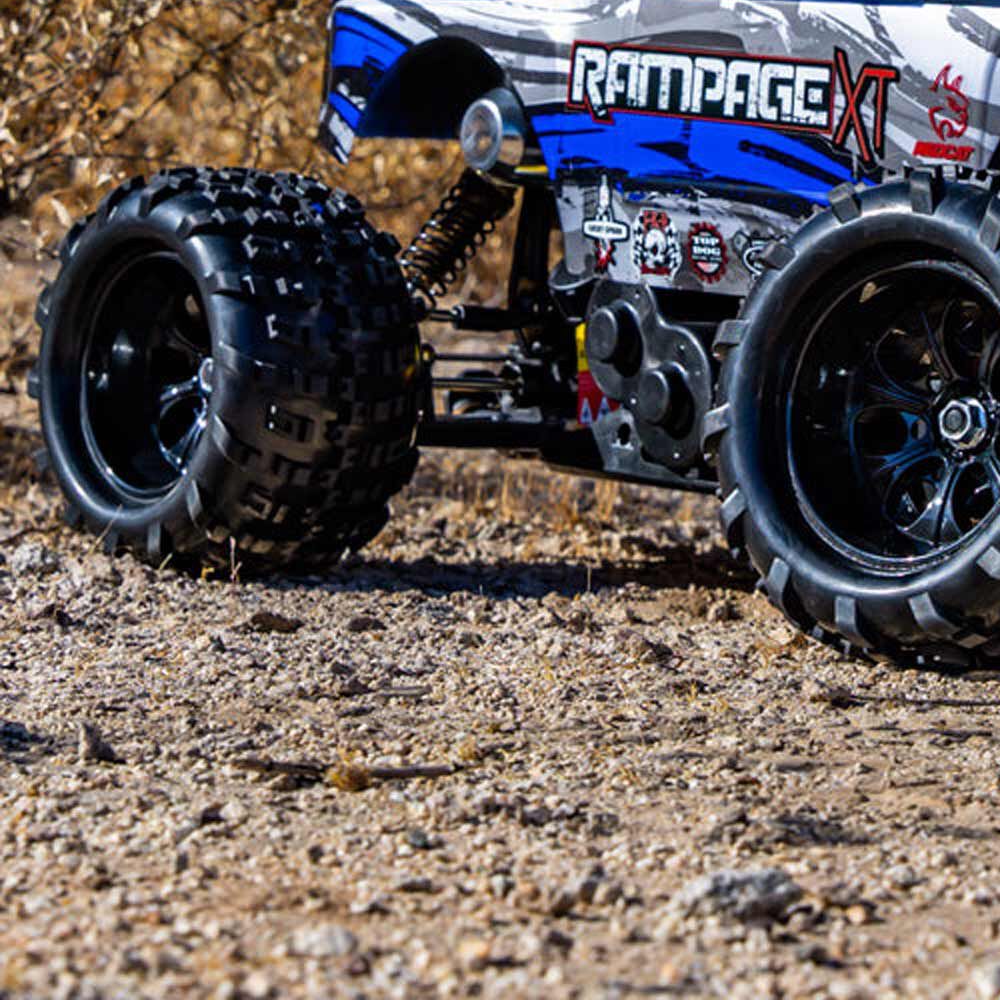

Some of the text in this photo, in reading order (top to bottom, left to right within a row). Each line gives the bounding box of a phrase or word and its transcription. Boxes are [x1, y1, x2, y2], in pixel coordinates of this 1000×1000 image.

[570, 45, 898, 164] RAMPAGE XT
[691, 235, 720, 247] TOP
[691, 246, 721, 257] DOG
